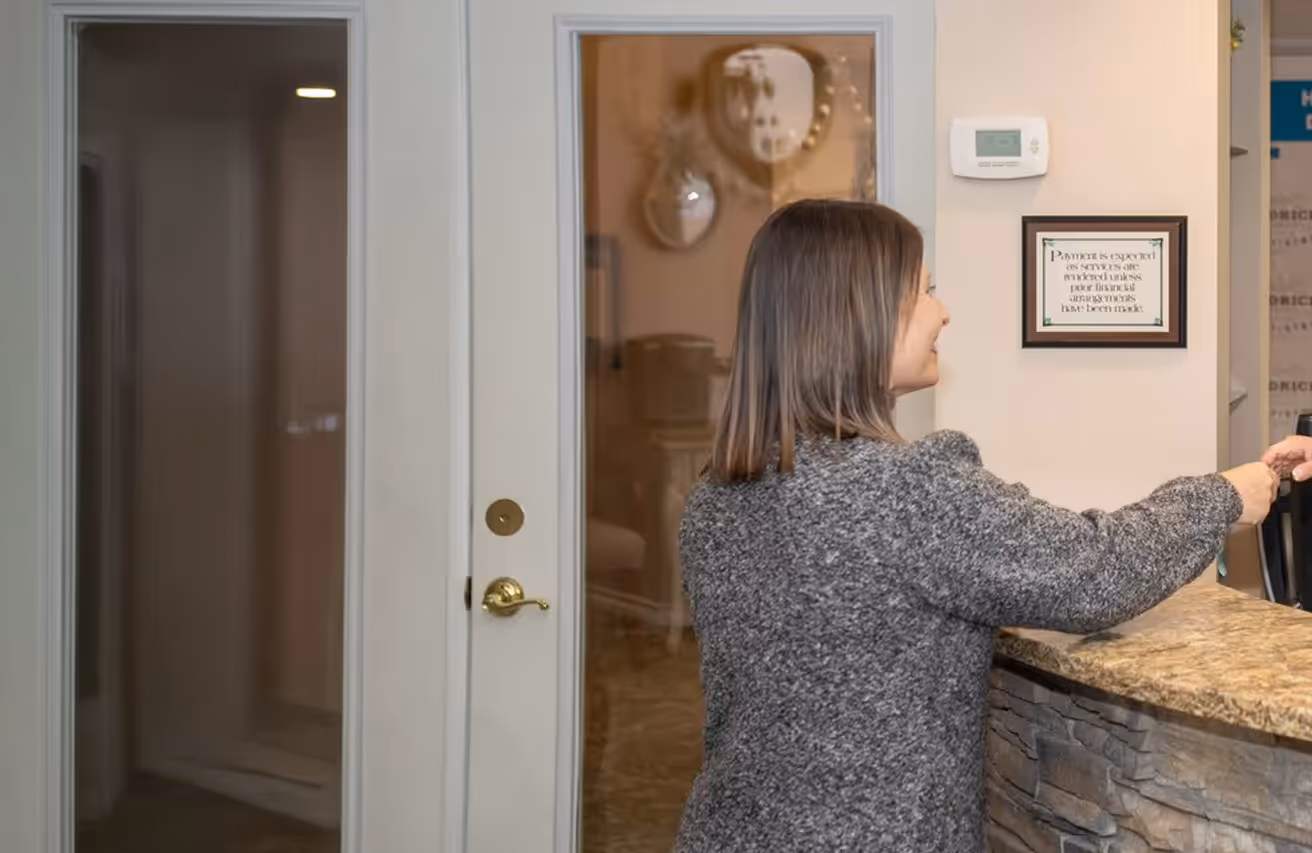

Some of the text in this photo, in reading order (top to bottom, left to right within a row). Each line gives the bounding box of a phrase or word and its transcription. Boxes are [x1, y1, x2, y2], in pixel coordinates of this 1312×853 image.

[1051, 250, 1156, 263] Payment is expected
[1066, 262, 1139, 271] as services are
[1064, 272, 1142, 281] rendered unless
[1070, 282, 1135, 293] prior financial
[1069, 294, 1136, 303] arrangements
[1061, 304, 1144, 313] have been made.
